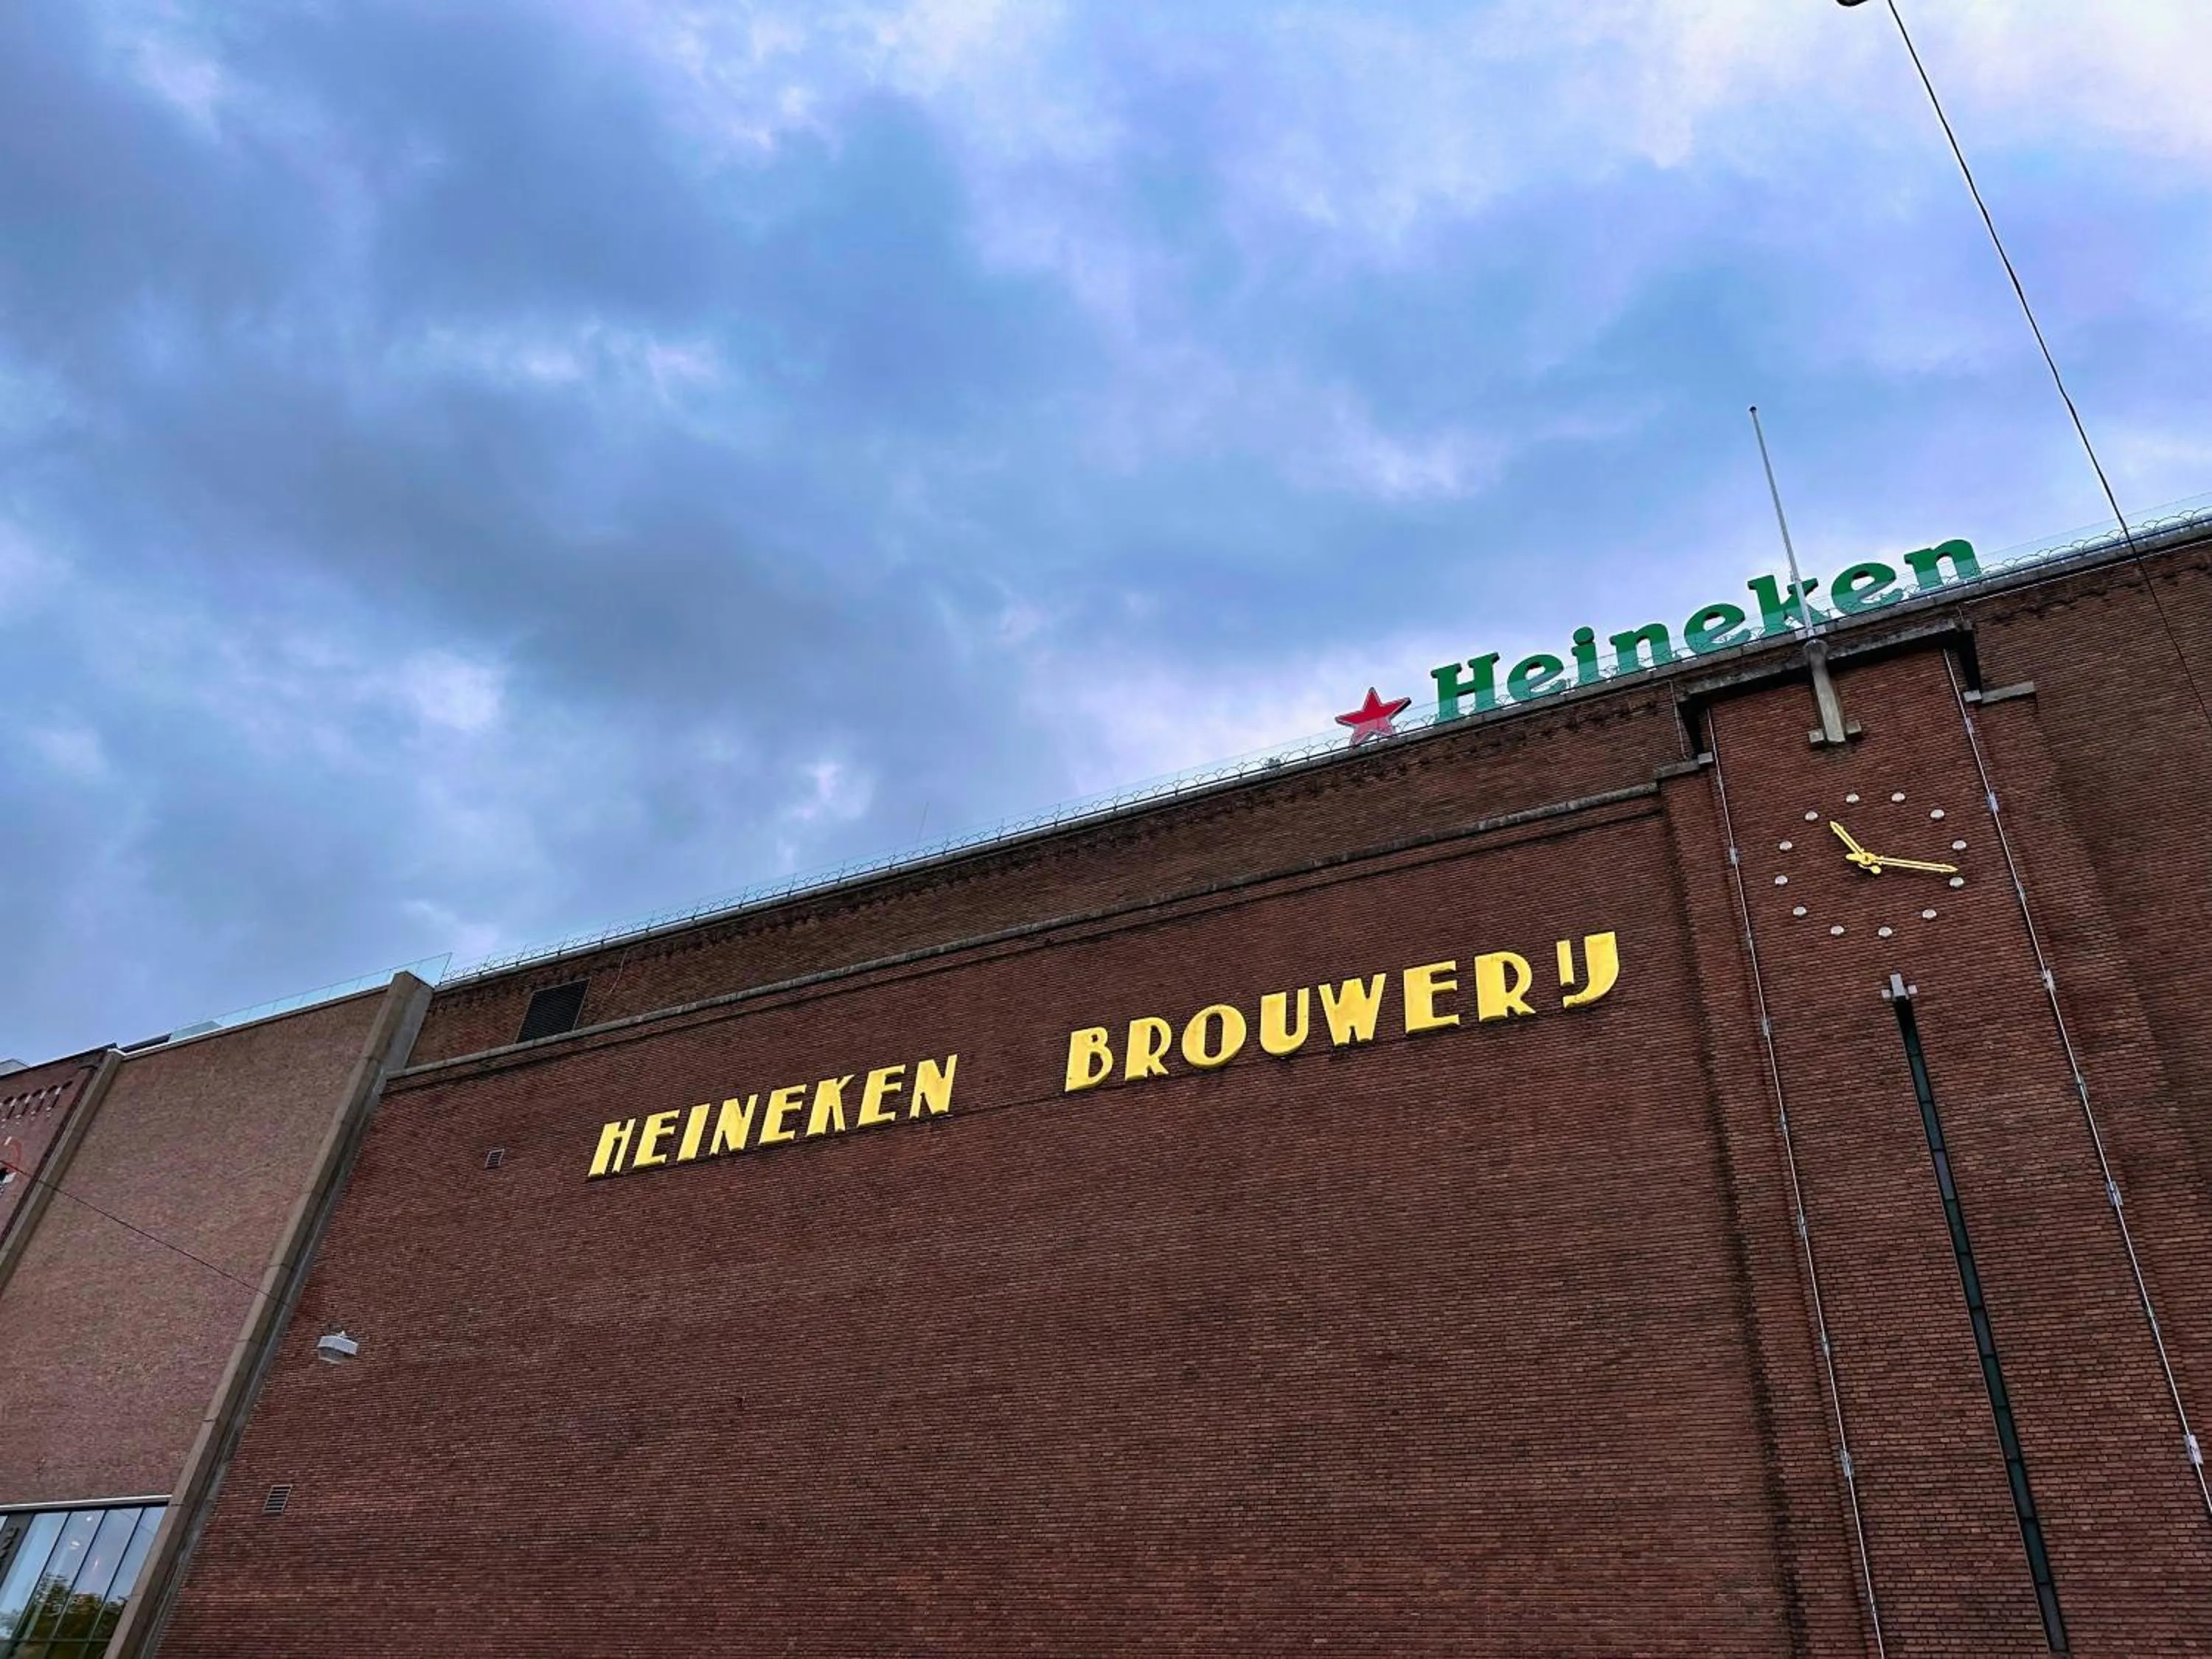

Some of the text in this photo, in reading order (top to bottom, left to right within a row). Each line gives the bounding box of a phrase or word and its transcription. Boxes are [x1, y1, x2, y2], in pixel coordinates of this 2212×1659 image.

[1430, 538, 1983, 723] Heineken
[588, 931, 1621, 1178] HEINEKEN BROUWERIJ
